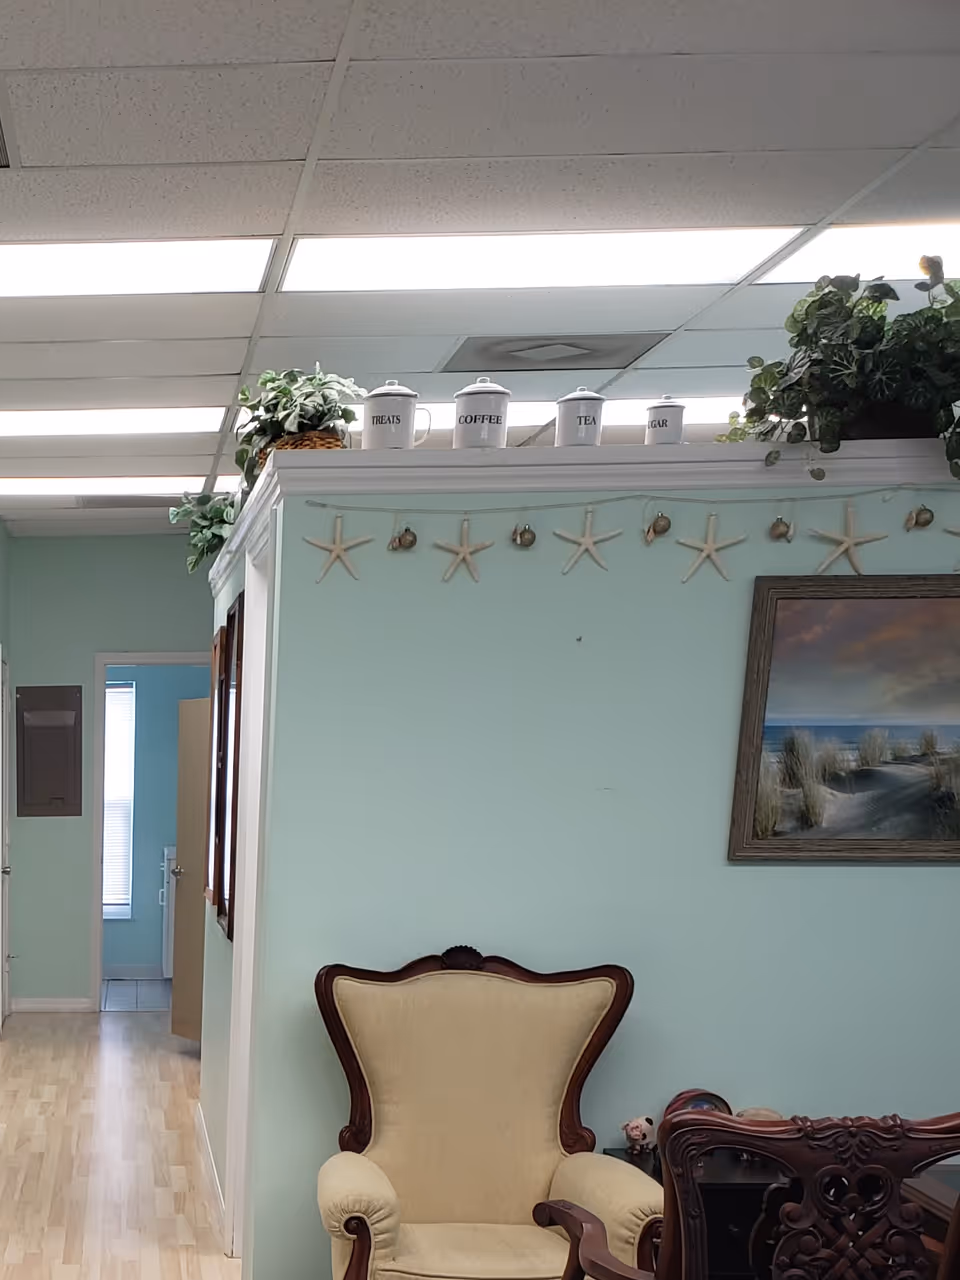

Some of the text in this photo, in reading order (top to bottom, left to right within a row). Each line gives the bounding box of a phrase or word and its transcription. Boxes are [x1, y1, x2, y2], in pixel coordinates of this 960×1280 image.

[372, 415, 401, 425] TREATS
[458, 414, 503, 425] COFFEE
[577, 415, 597, 426] TEA
